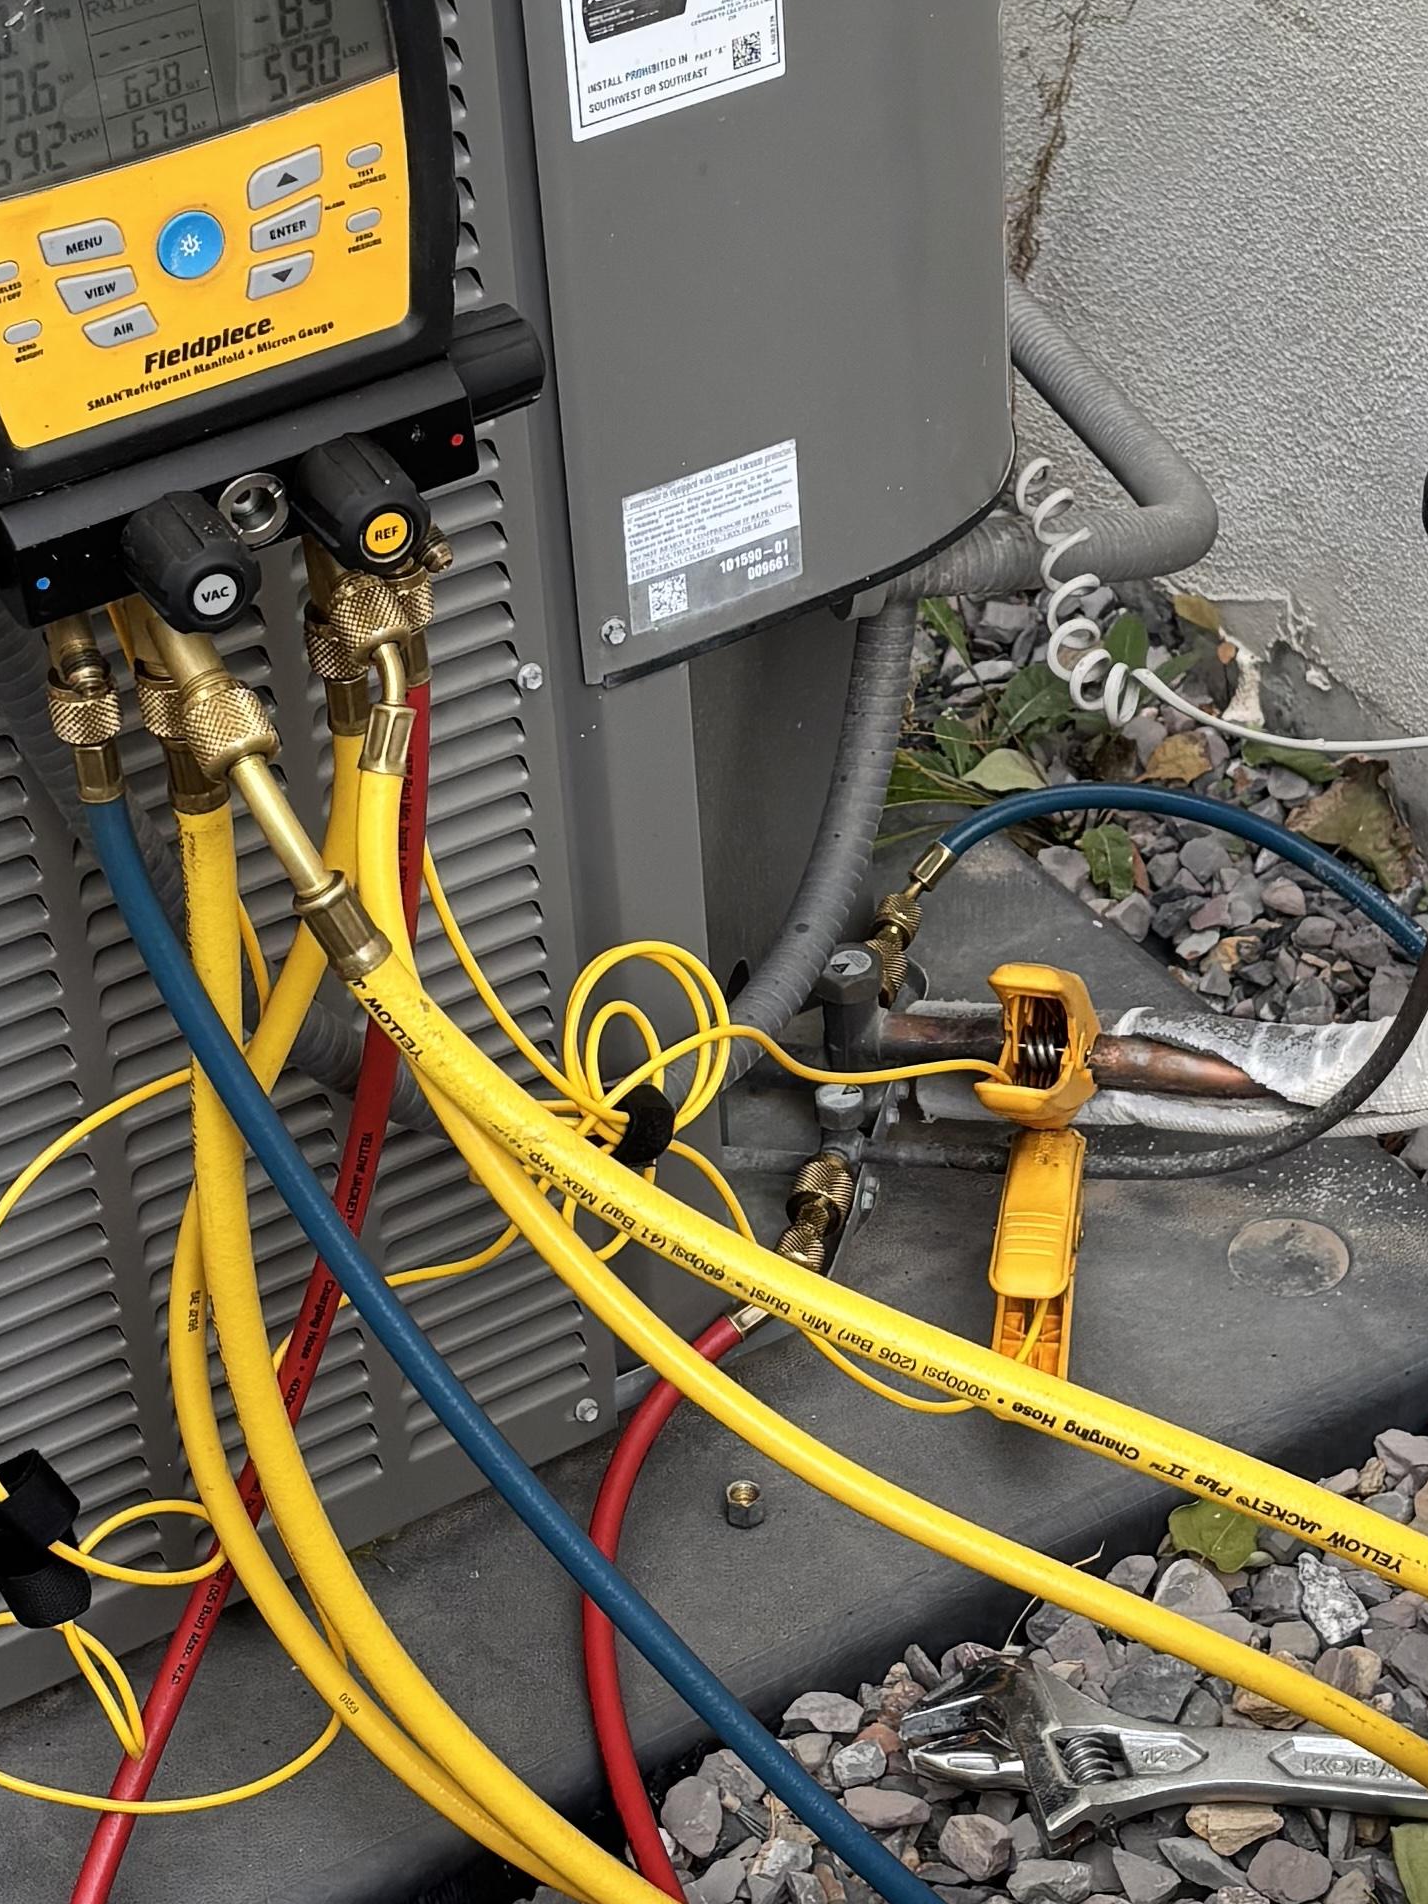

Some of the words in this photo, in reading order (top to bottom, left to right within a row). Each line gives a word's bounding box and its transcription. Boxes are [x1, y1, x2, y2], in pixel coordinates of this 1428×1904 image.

[265, 35, 341, 102] 59.0
[587, 75, 622, 95] INSTALL
[625, 57, 676, 82] PROHIBITED
[678, 53, 688, 65] IN
[2, 60, 57, 124] 3.6
[588, 88, 641, 114] SOUTHWEST
[644, 83, 657, 96] OR
[659, 66, 708, 90] SOUTHEAST
[66, 235, 103, 255] MENU
[269, 220, 307, 240] ENTER
[84, 282, 117, 300] VIEW
[113, 322, 134, 337] AIR
[125, 368, 192, 399] Refrigerant
[194, 350, 245, 375] Manifold
[257, 333, 296, 354] Micron
[298, 321, 335, 340] Gauge
[144, 317, 272, 375] Fieldpiece
[374, 526, 400, 542] REF
[201, 586, 230, 604] VAC
[364, 998, 423, 1061] YELLOW
[357, 1132, 373, 1174] YELLOW
[562, 1173, 598, 1205] Max.
[601, 1202, 635, 1231] Bar)
[642, 1227, 666, 1249] (41
[670, 1246, 725, 1281] 600psi
[316, 1279, 336, 1329] Charging
[749, 1285, 790, 1316] burst
[799, 1307, 833, 1335] Min.
[301, 1331, 318, 1360] Hose
[837, 1327, 874, 1354] Bar)
[878, 1347, 917, 1371] (206
[922, 1364, 991, 1402] 3000psi
[1012, 1401, 1058, 1429] Hose
[1064, 1419, 1141, 1461] Charging
[1193, 1474, 1232, 1497] Plus
[1326, 1530, 1403, 1575] YELLOW
[1305, 1758, 1410, 1781] KOBA
